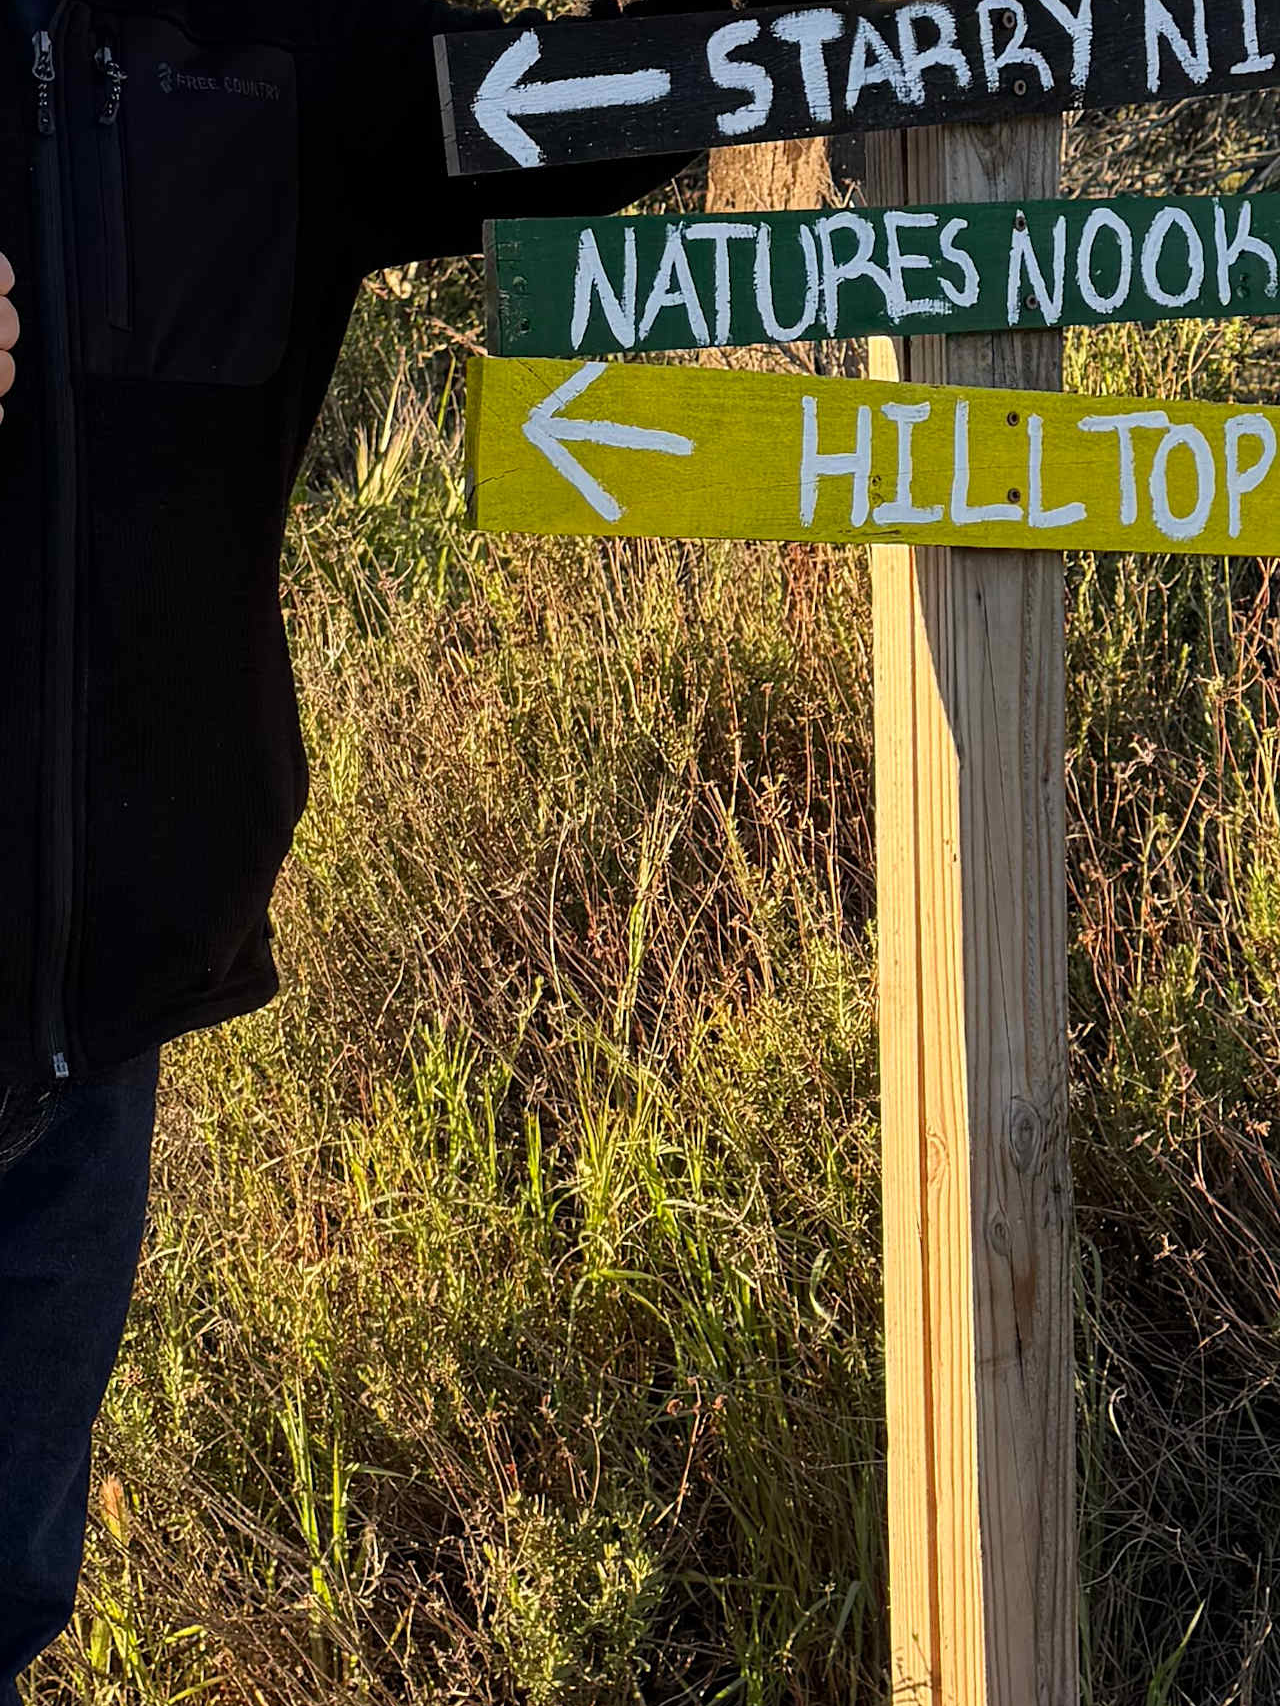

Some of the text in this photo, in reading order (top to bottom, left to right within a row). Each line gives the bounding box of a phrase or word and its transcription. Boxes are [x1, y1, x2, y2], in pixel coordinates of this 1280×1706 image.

[175, 73, 281, 101] FREE COUNTRY
[571, 197, 1280, 351] NATURES NOOK
